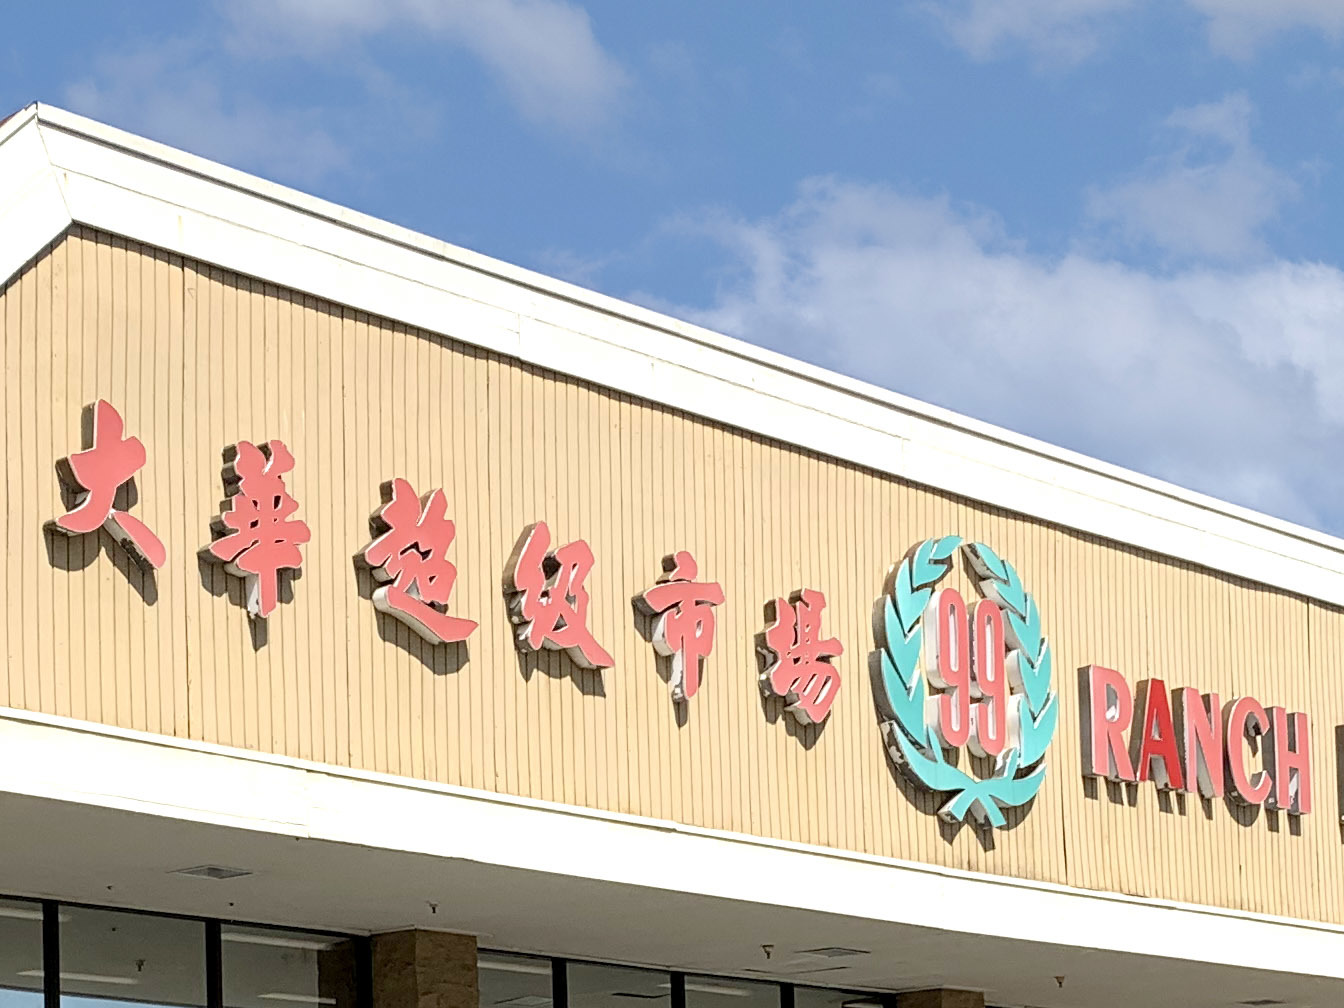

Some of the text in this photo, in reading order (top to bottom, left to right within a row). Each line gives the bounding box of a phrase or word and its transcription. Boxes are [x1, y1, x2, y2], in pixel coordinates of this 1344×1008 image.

[50, 398, 844, 726] 大華超級市場
[931, 586, 1008, 758] 99
[1086, 663, 1312, 815] RANCH
